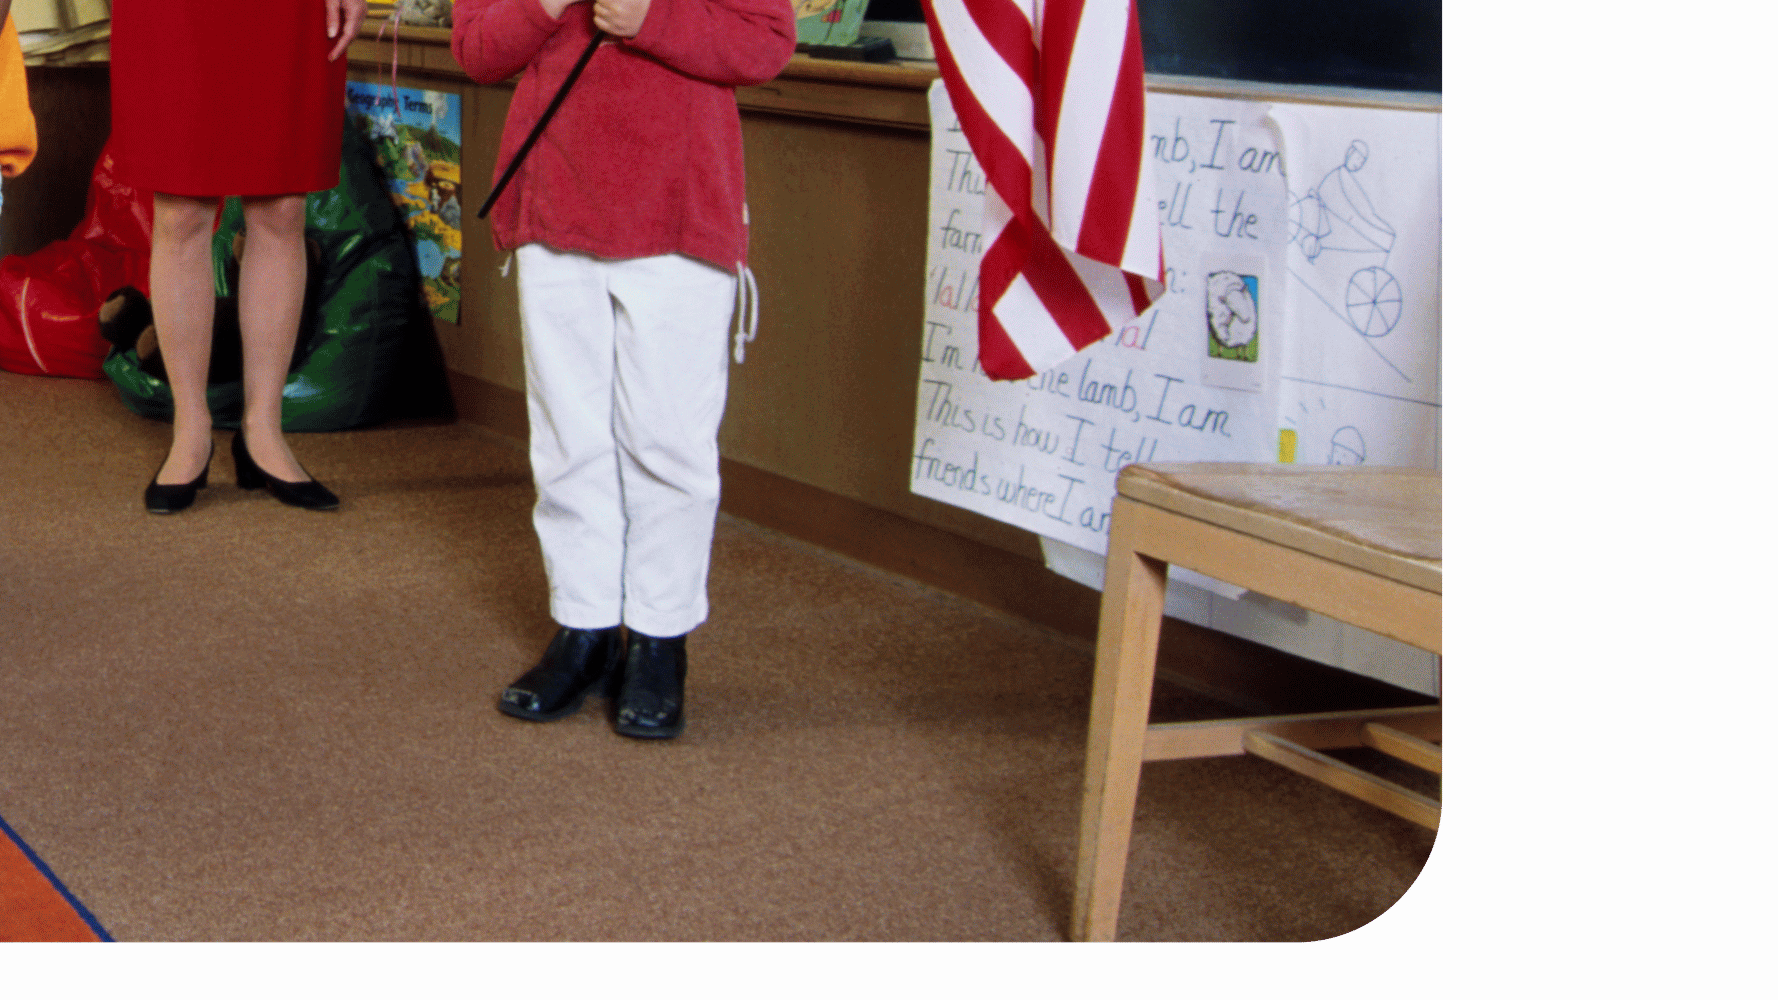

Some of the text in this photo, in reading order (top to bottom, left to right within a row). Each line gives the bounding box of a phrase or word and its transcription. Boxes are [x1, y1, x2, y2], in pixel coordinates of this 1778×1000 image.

[1199, 118, 1237, 171] I
[1237, 146, 1288, 179] am
[945, 148, 1259, 241] Thi ell the
[922, 378, 977, 434] This
[982, 412, 1006, 442] is
[1011, 404, 1060, 455] how
[1060, 413, 1096, 467] I
[1078, 358, 1141, 423] lamb,
[1144, 373, 1185, 425] I
[1177, 403, 1232, 438] am
[996, 463, 1056, 514] where
